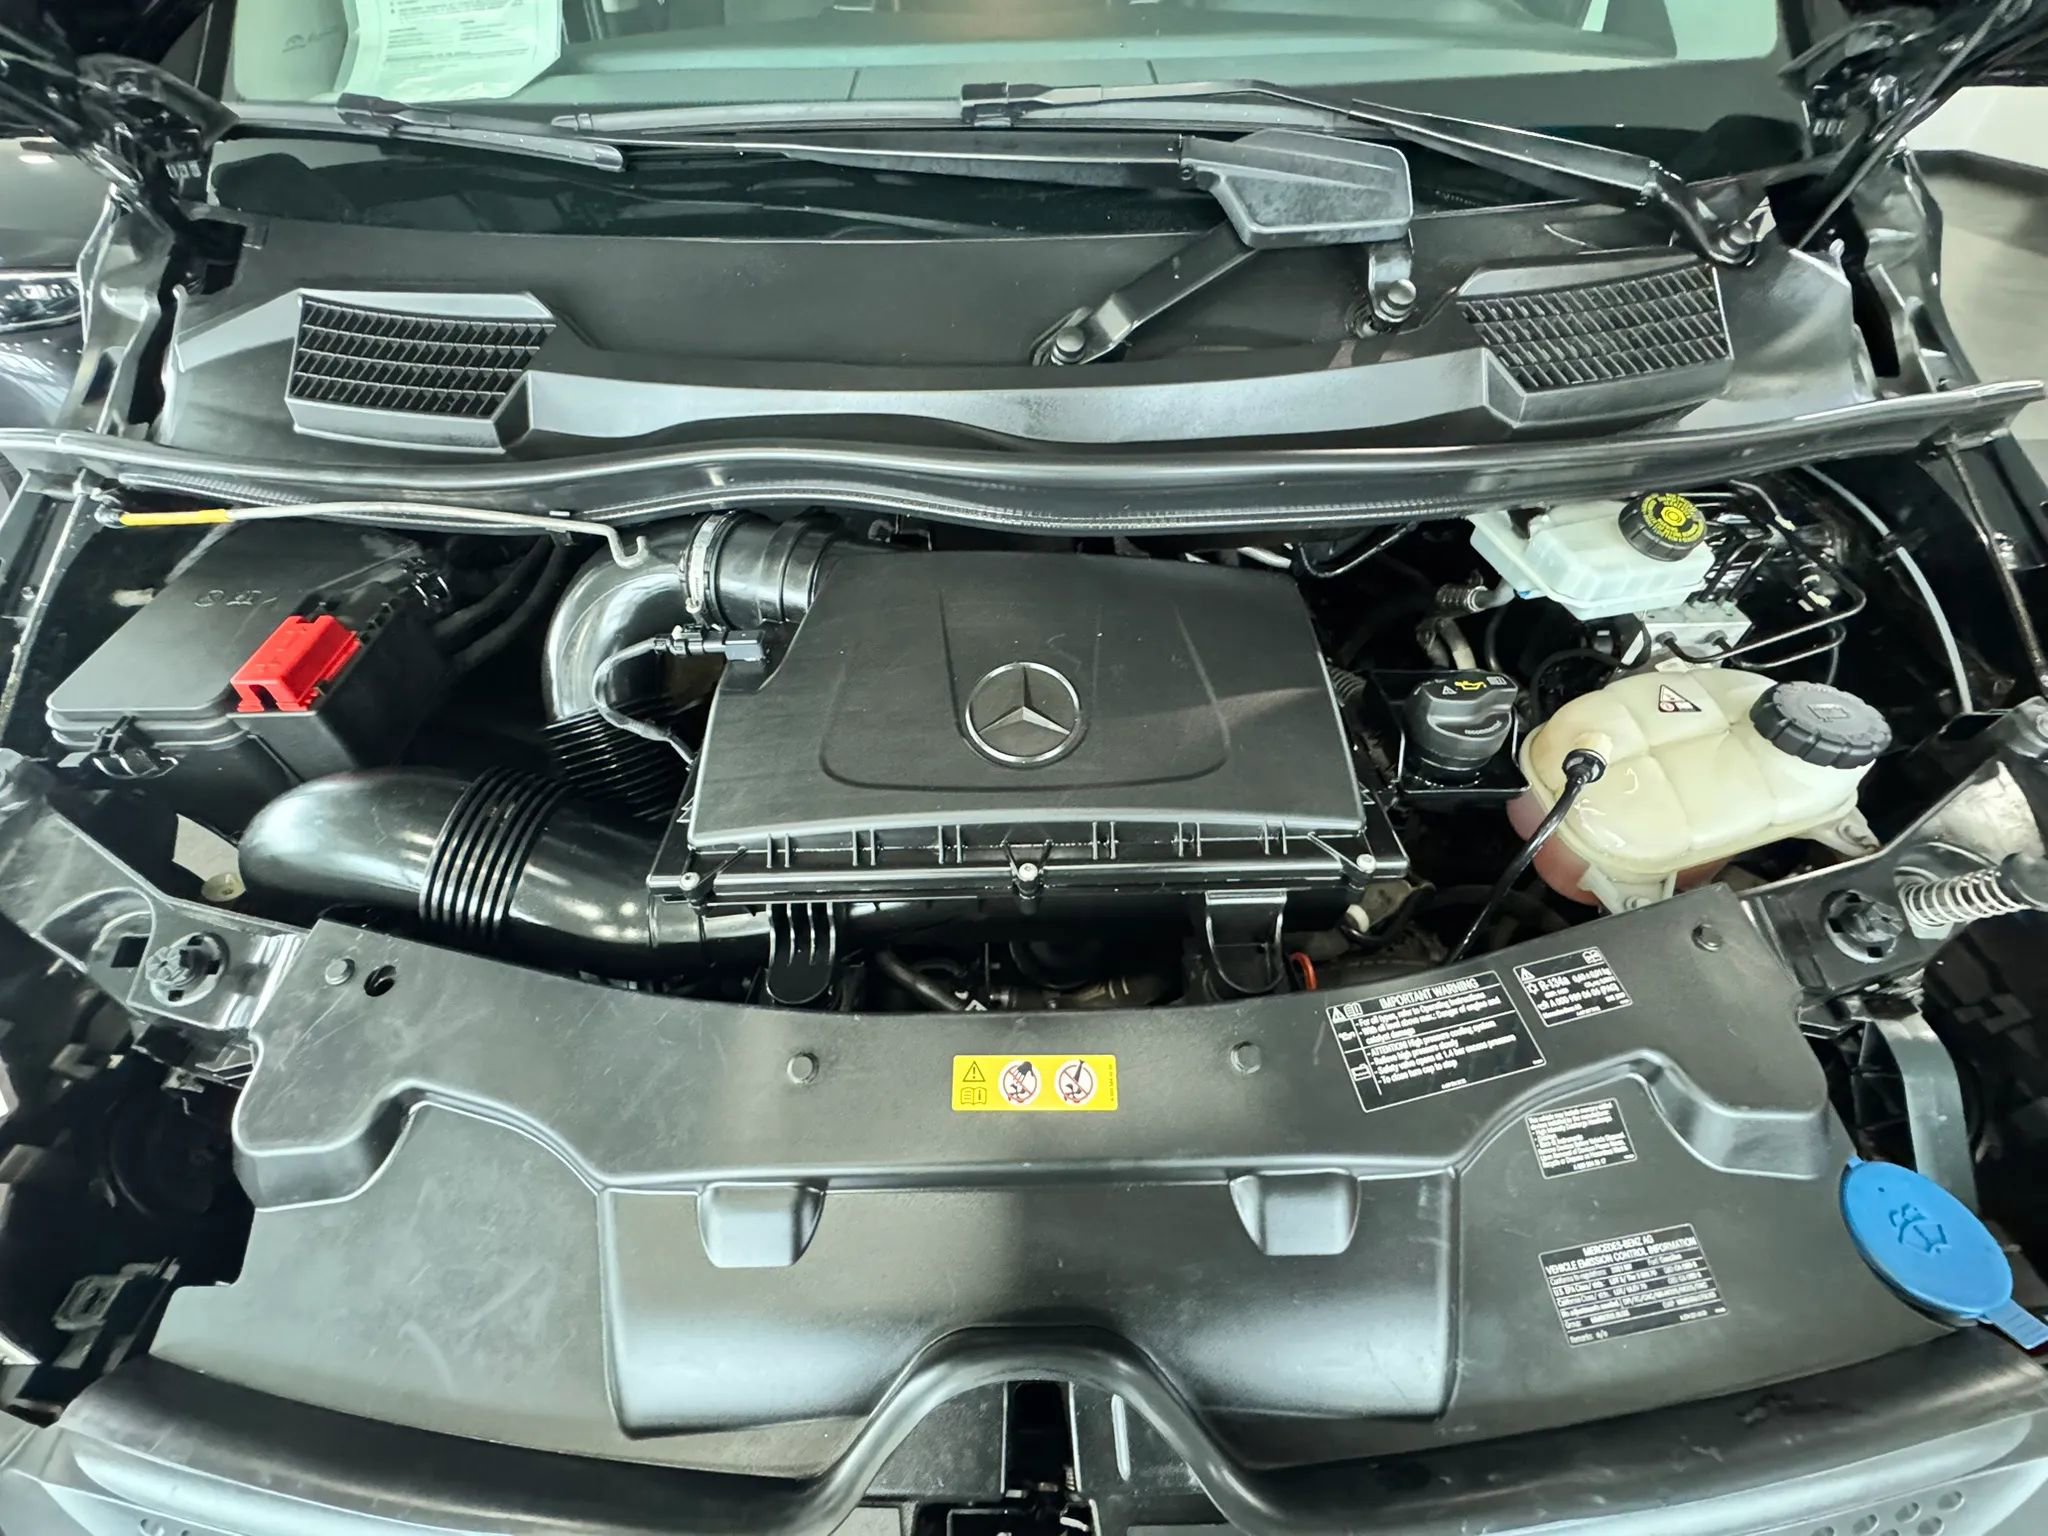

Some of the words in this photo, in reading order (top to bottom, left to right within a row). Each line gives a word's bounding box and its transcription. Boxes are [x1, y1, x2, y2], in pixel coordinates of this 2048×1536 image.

[1537, 976, 1570, 991] R-134a
[1379, 990, 1432, 1009] IMPORTANT
[1431, 978, 1479, 997] WARNING
[1435, 1007, 1459, 1019] Danger
[1358, 1018, 1370, 1027] For
[1380, 1075, 1391, 1084] To
[1582, 1237, 1642, 1256] MERCEDES-BENZ
[1642, 1234, 1654, 1244] AG
[1545, 1260, 1577, 1274] VEHICLE
[1576, 1254, 1613, 1269] EMISSION
[1613, 1247, 1648, 1261] CONTROL
[1647, 1237, 1696, 1254] INFORMATION
